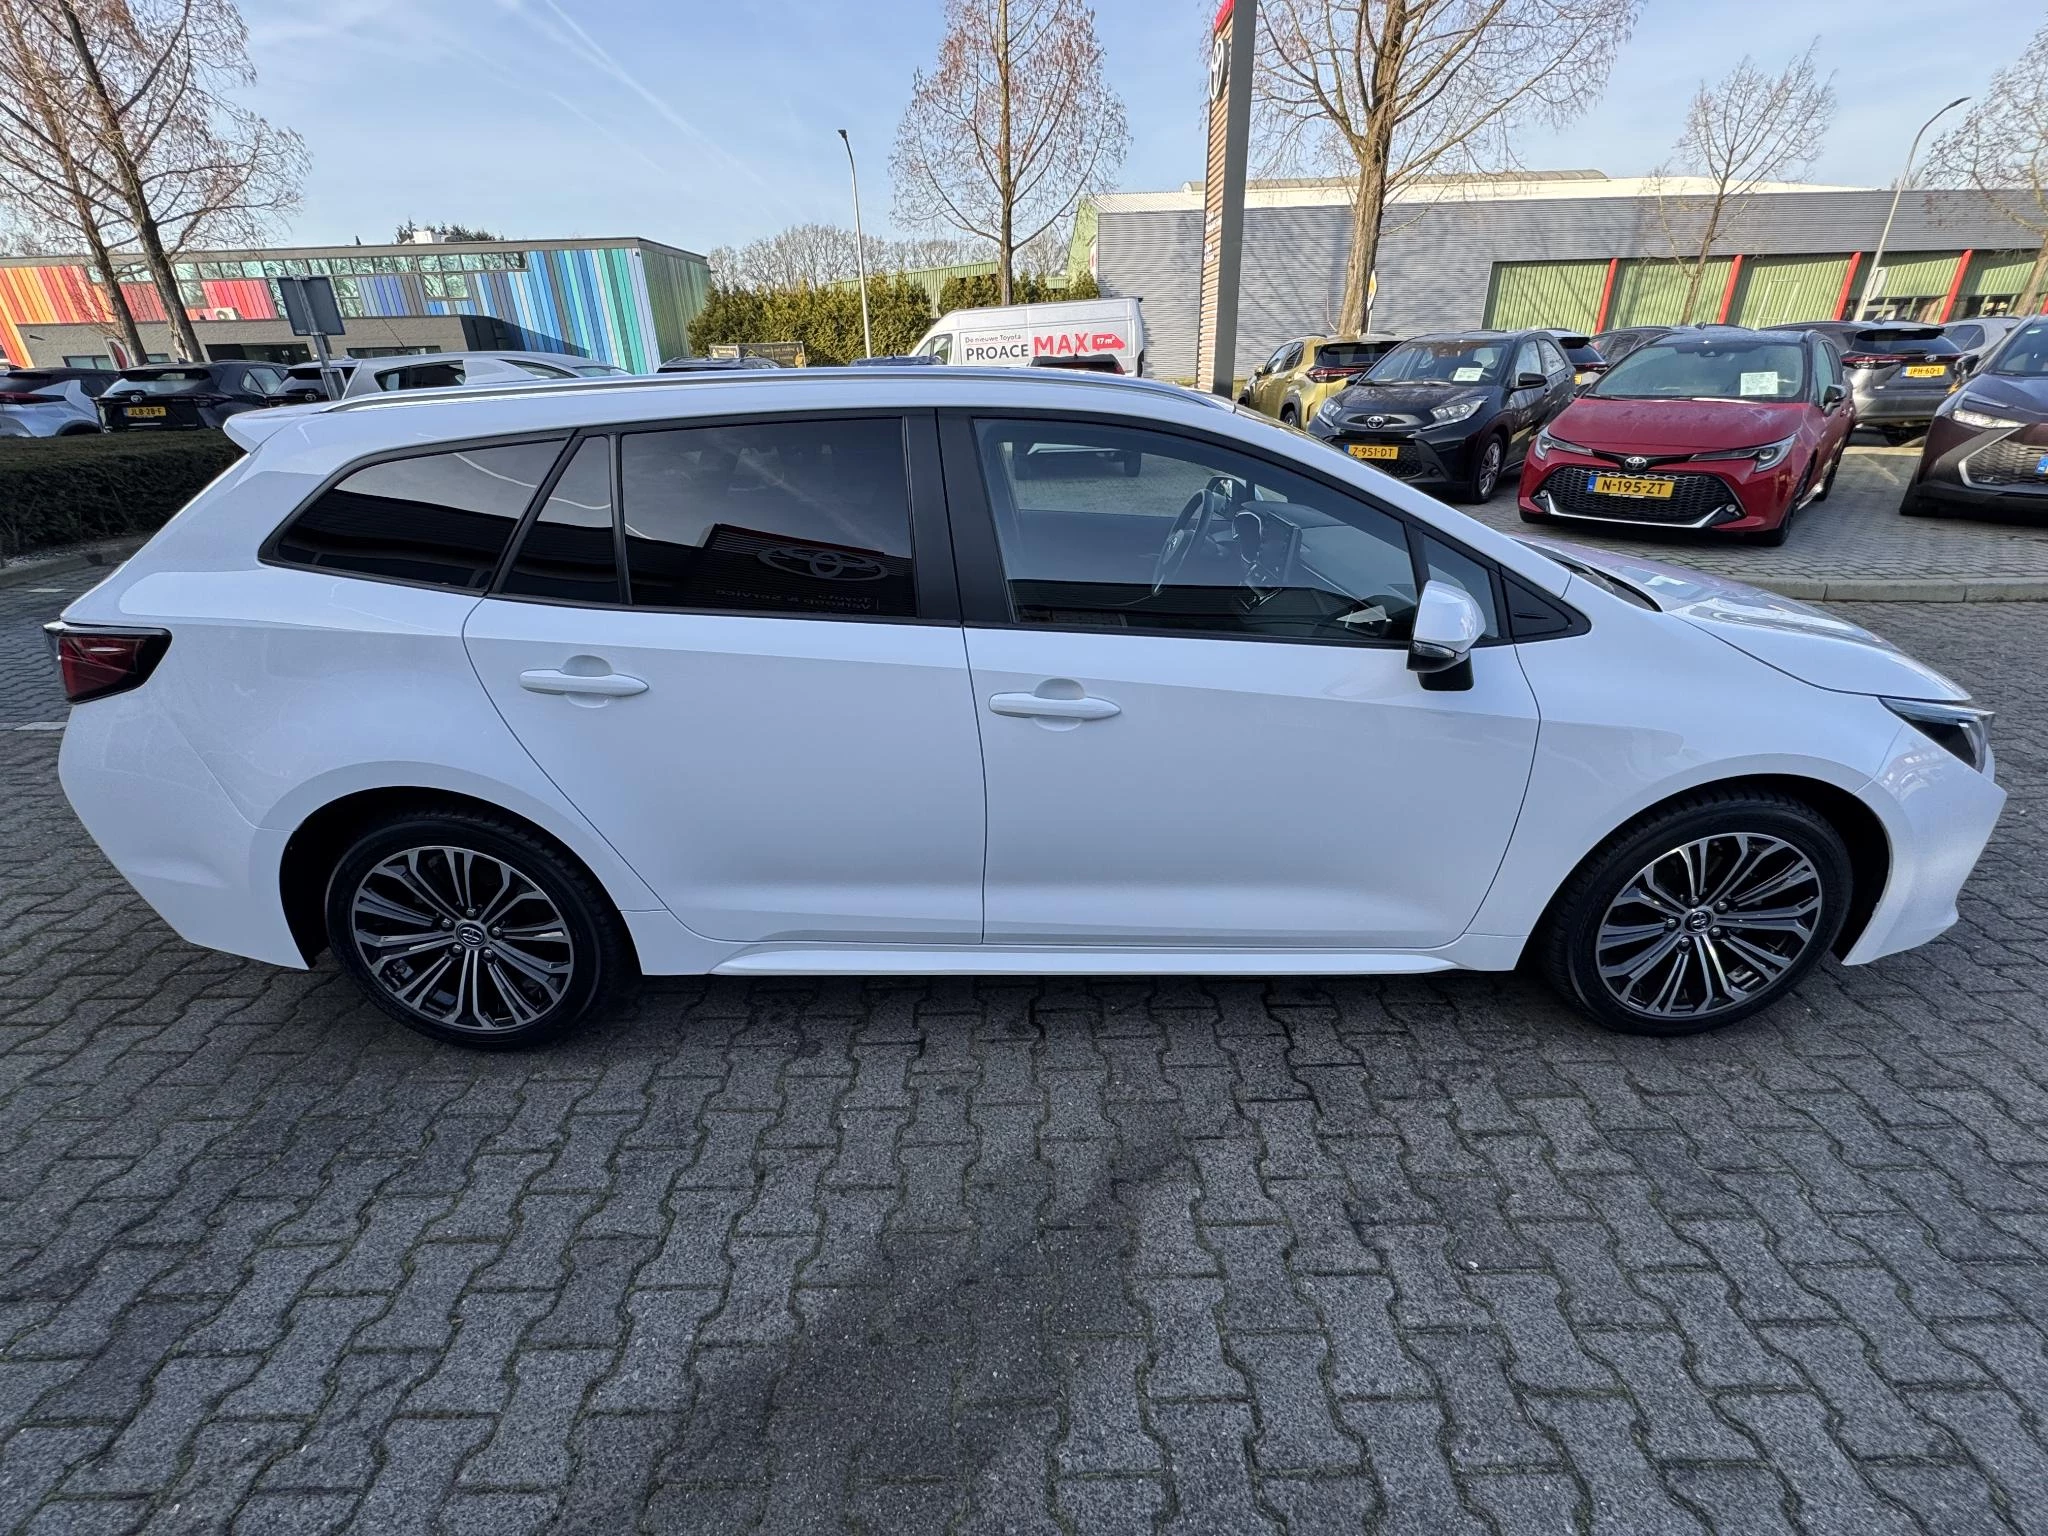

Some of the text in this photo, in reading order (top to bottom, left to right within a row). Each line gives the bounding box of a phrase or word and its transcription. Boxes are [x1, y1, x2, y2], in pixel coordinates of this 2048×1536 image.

[966, 333, 1088, 361] PROACE MAX
[1352, 447, 1393, 458] Z-951-DT
[1602, 480, 1665, 494] N-195-ZT
